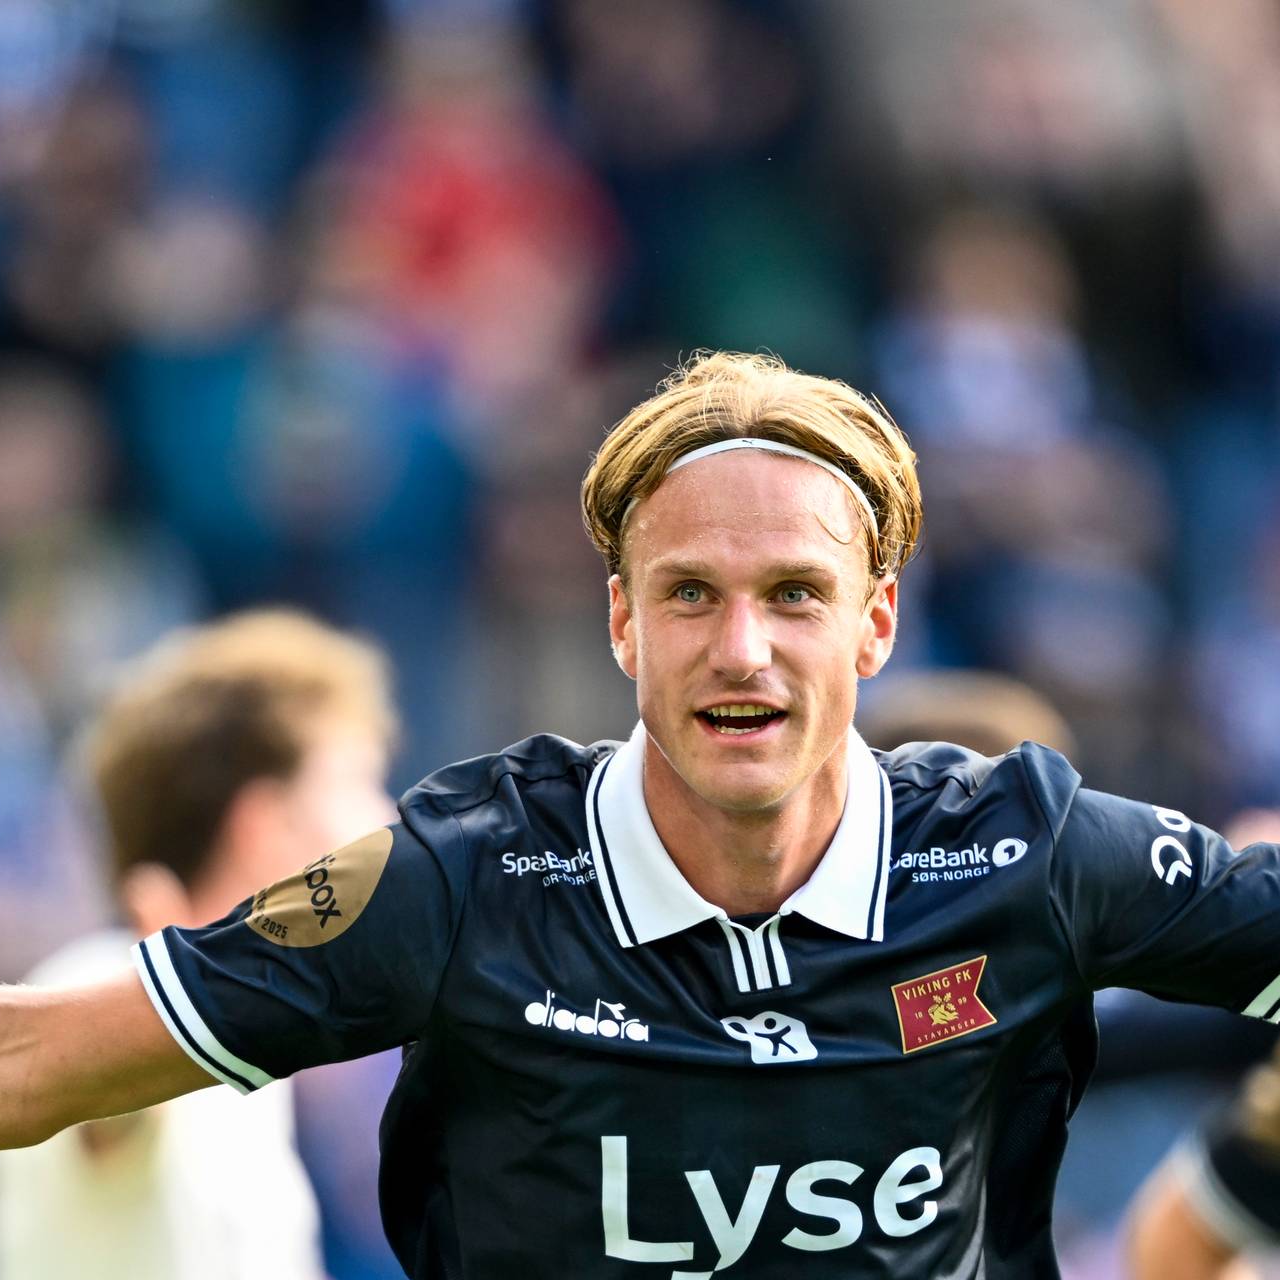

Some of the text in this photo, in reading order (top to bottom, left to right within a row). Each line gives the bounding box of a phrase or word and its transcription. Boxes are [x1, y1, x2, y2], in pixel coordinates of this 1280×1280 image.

[911, 865, 991, 883] SØR-NORGE
[902, 968, 972, 1001] VIKING FK
[524, 989, 650, 1043] diadora
[916, 1018, 976, 1044] STAVANGER
